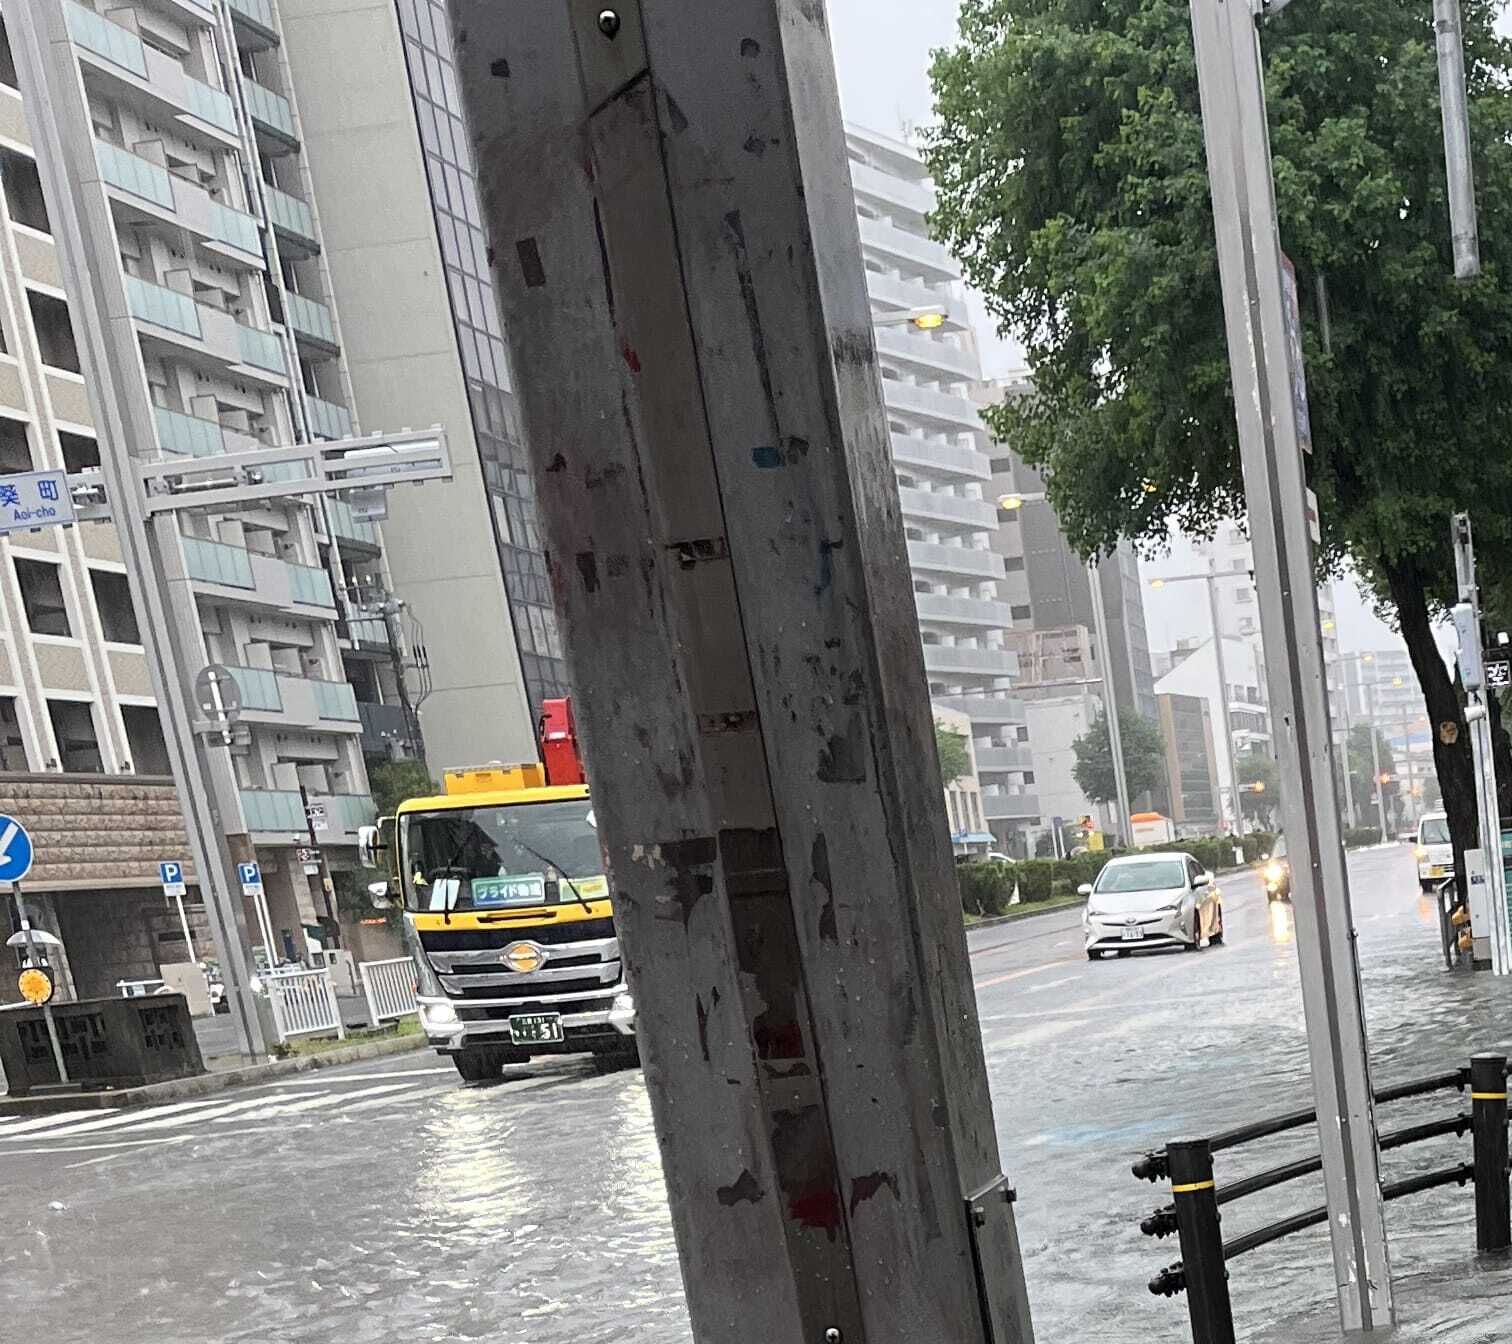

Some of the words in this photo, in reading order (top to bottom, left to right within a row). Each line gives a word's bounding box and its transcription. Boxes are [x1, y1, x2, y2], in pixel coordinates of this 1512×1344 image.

[14, 506, 56, 520] Aoi-cho
[164, 864, 178, 882] P
[243, 865, 256, 882] P
